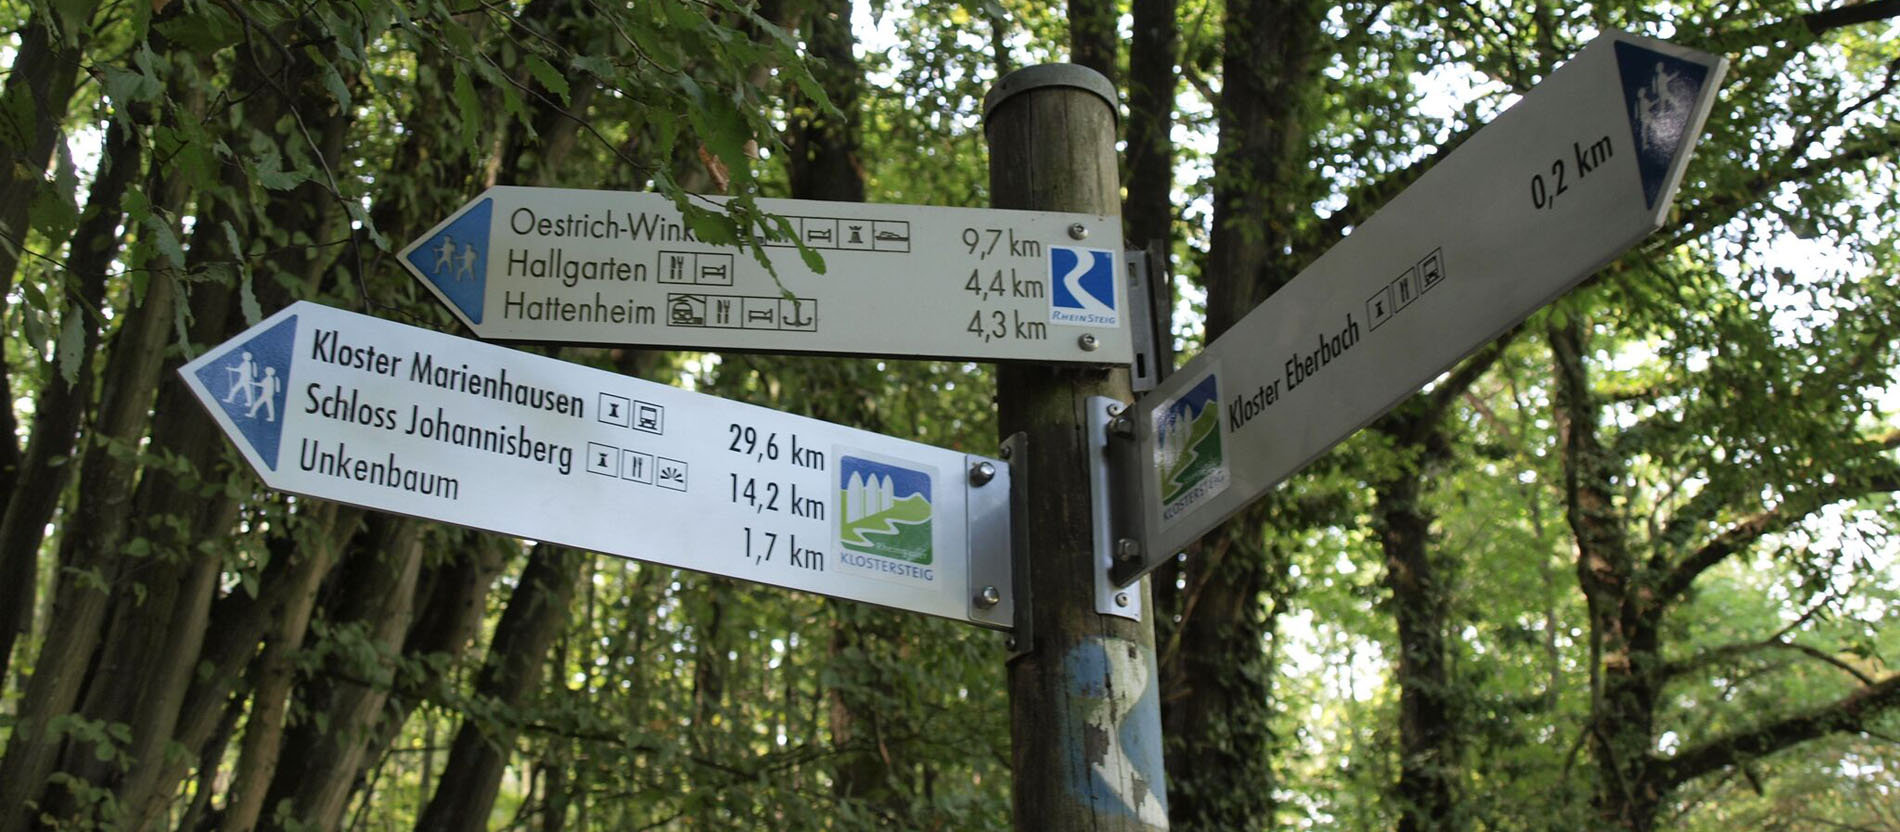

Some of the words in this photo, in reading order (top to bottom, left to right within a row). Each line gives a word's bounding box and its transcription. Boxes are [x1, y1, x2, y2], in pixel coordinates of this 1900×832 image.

[1531, 159, 1568, 210] 0,2
[1574, 136, 1614, 178] km
[510, 207, 700, 242] Oestrich-Wink
[962, 228, 1003, 260] 9,7
[1009, 228, 1041, 258] km
[507, 249, 647, 287] Hallgarten
[965, 268, 1006, 301] 4,4
[1012, 268, 1044, 299] km
[504, 291, 655, 325] Hattenheim
[967, 310, 1007, 343] 4,3
[1014, 310, 1047, 340] km
[312, 329, 402, 378] Kloster
[409, 351, 584, 418] Marienhausen
[1228, 379, 1281, 432] Kloster
[1284, 313, 1360, 391] Eberbach
[304, 382, 397, 430] Schloss
[405, 404, 573, 475] Johannisberg
[728, 423, 780, 463] 29,6
[791, 434, 825, 471] km
[299, 437, 459, 500] Unkenbaum
[730, 473, 780, 514] 14,2
[791, 484, 825, 521] km
[1163, 474, 1225, 521] KLOSTERSTEIG
[743, 527, 777, 566] 1,7
[790, 534, 824, 571] km
[840, 552, 934, 581] KLOSTERSTEIG
